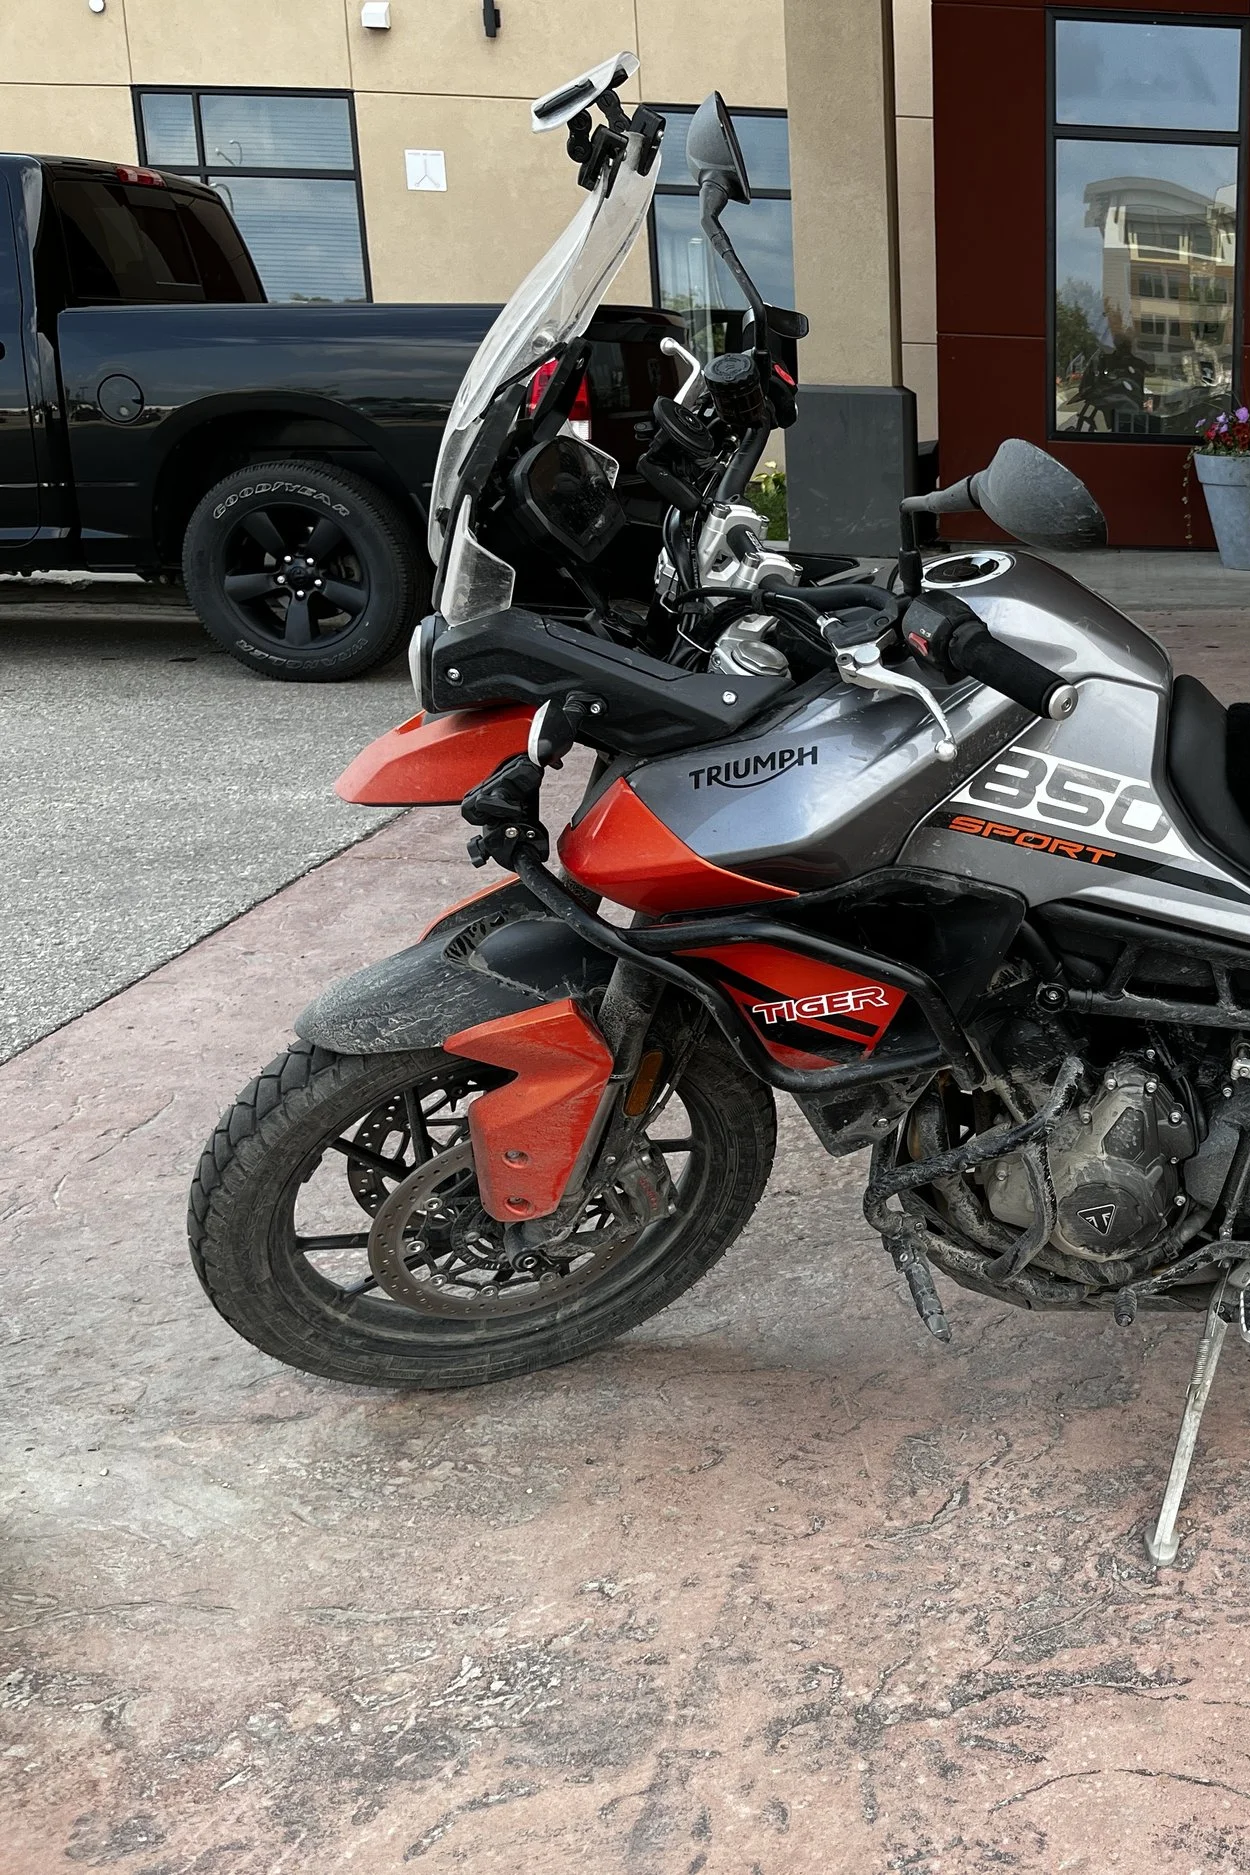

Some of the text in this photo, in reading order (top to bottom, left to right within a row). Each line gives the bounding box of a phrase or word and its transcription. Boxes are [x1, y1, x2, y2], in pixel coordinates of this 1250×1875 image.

[236, 638, 369, 669] WRANGLER
[689, 746, 818, 789] TRIUMPH
[969, 752, 1172, 844] 850
[949, 816, 1116, 863] SPORT
[752, 986, 889, 1024] TIGER
